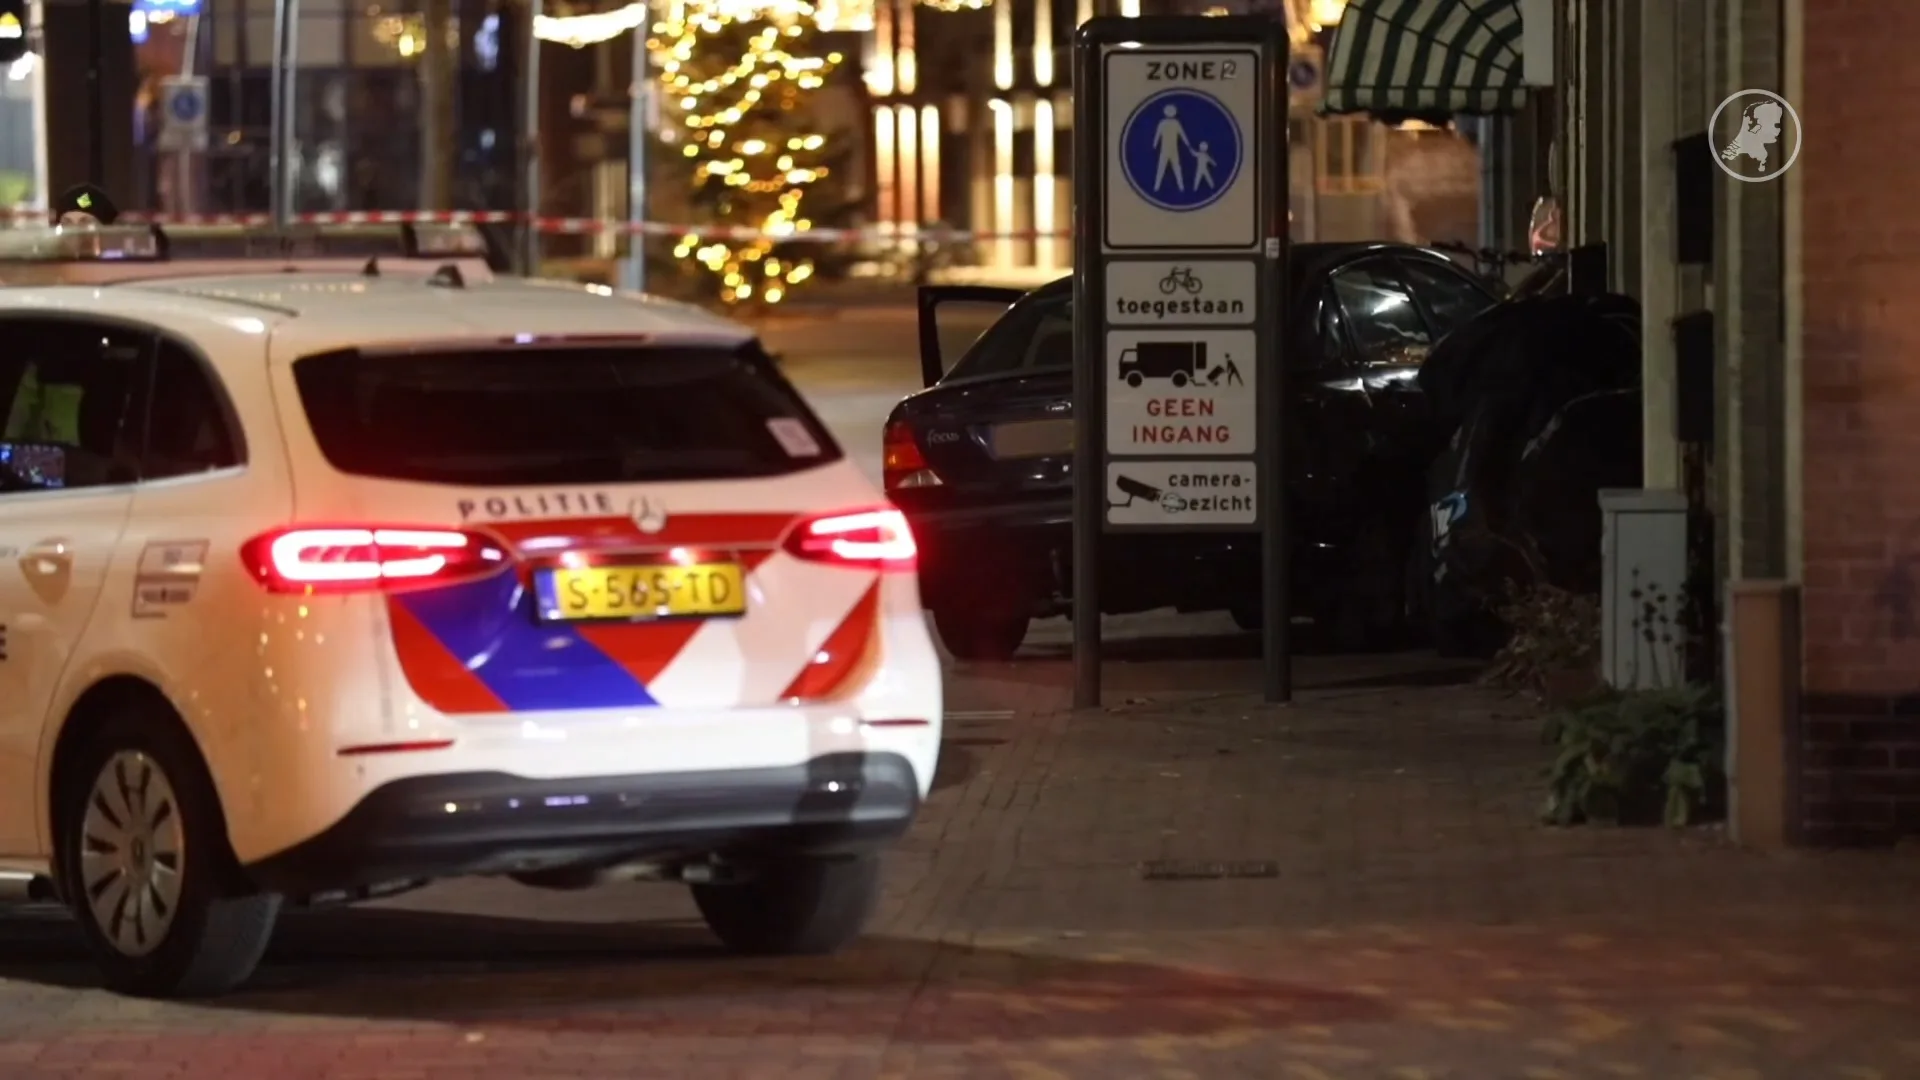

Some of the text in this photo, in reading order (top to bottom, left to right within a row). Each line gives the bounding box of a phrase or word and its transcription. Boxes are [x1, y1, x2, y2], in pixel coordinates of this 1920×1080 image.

[1146, 61, 1216, 80] ZONE
[1117, 298, 1244, 319] toegestaan
[1146, 399, 1214, 416] GEEN
[1132, 425, 1230, 443] INGANG
[1168, 474, 1252, 487] camera-
[457, 492, 613, 520] POLITIE
[1167, 495, 1252, 511] oezicht
